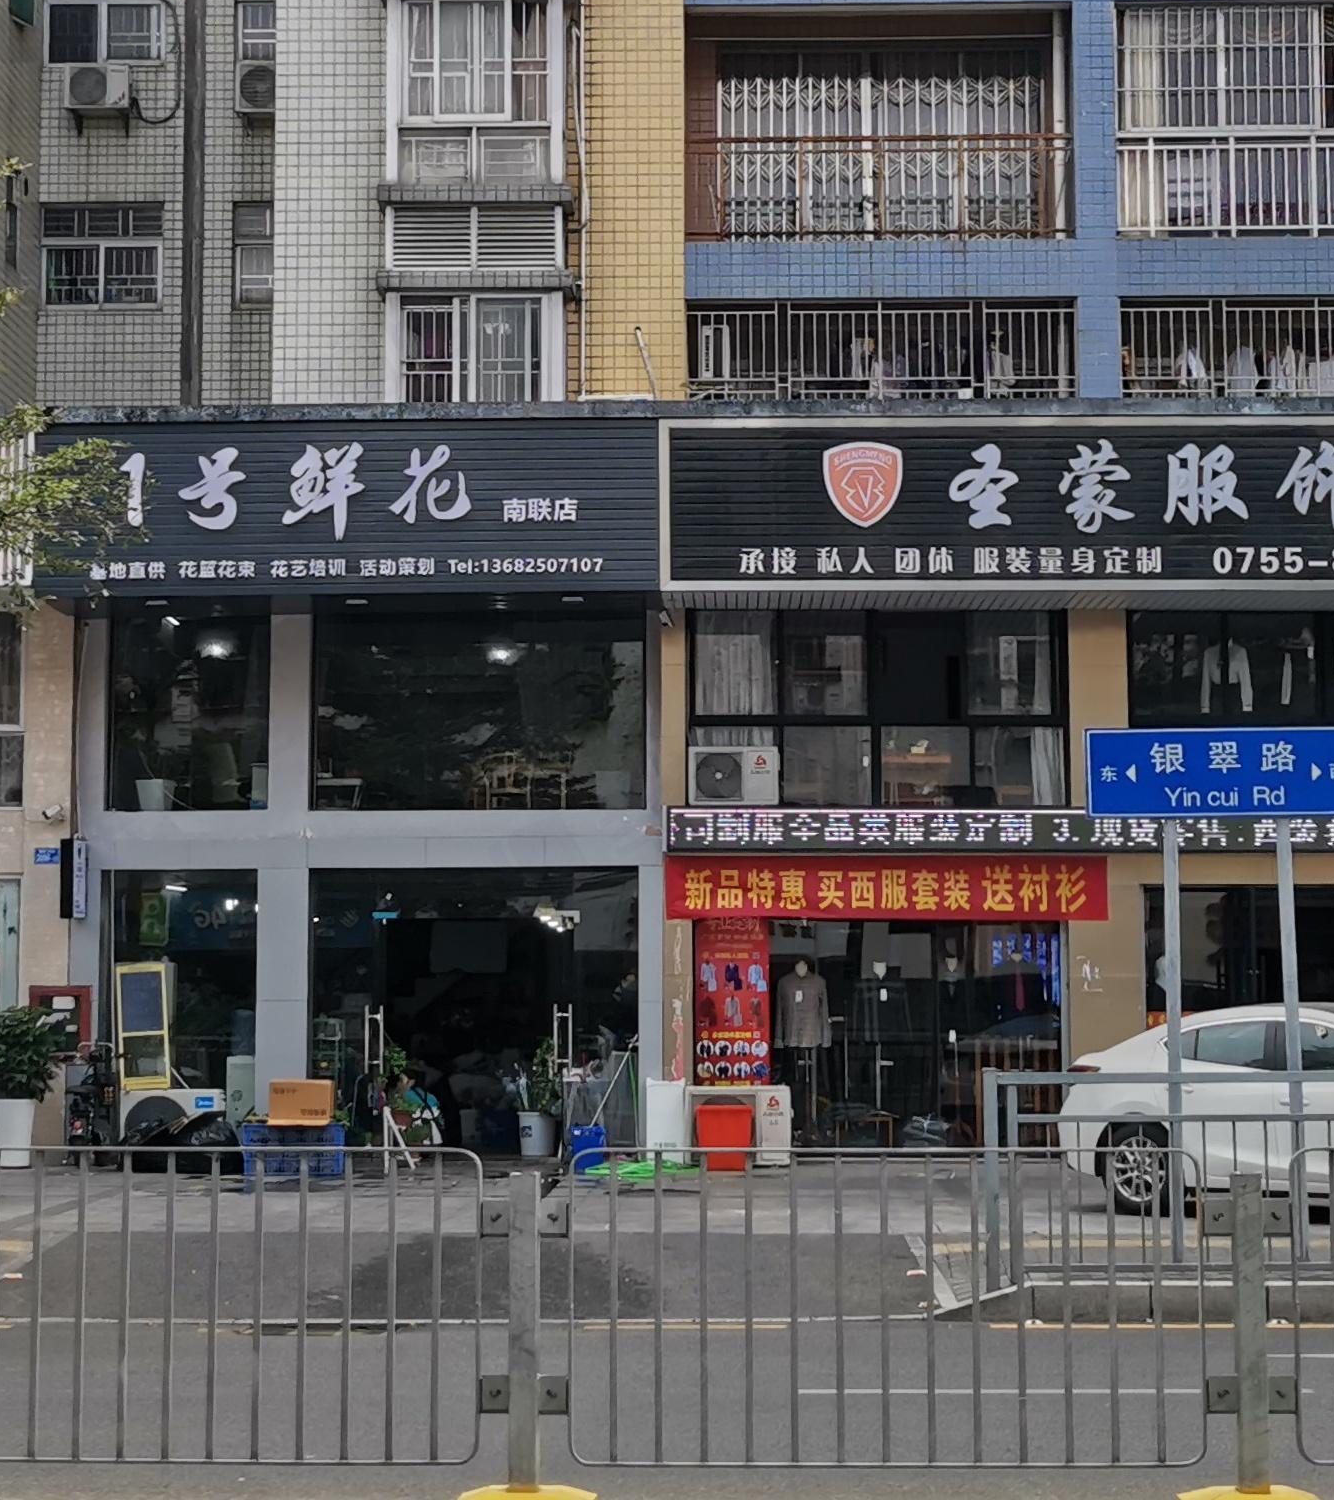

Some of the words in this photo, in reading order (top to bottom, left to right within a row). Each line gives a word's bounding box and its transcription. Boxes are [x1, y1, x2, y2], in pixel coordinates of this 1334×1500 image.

[118, 441, 472, 541] 1号鲜花
[502, 498, 578, 523] 南联店
[178, 560, 256, 580] 花篮花束
[269, 558, 347, 579] 花艺培训
[359, 558, 436, 579] 活动策划
[448, 556, 604, 577] Tel:13682507107
[738, 546, 798, 575] 承接
[816, 546, 875, 575] 私人
[894, 546, 955, 575] 团体
[973, 545, 1164, 575] 服装量身定制
[1100, 765, 1118, 783] 东
[1149, 740, 1298, 775] 银翠路
[1164, 787, 1201, 807] Yin
[1207, 787, 1239, 806] cui
[1253, 786, 1286, 806] Rd
[684, 868, 807, 910] 新品特惠
[817, 868, 971, 911] 买西服套装
[982, 864, 1088, 913] 送衬衫
